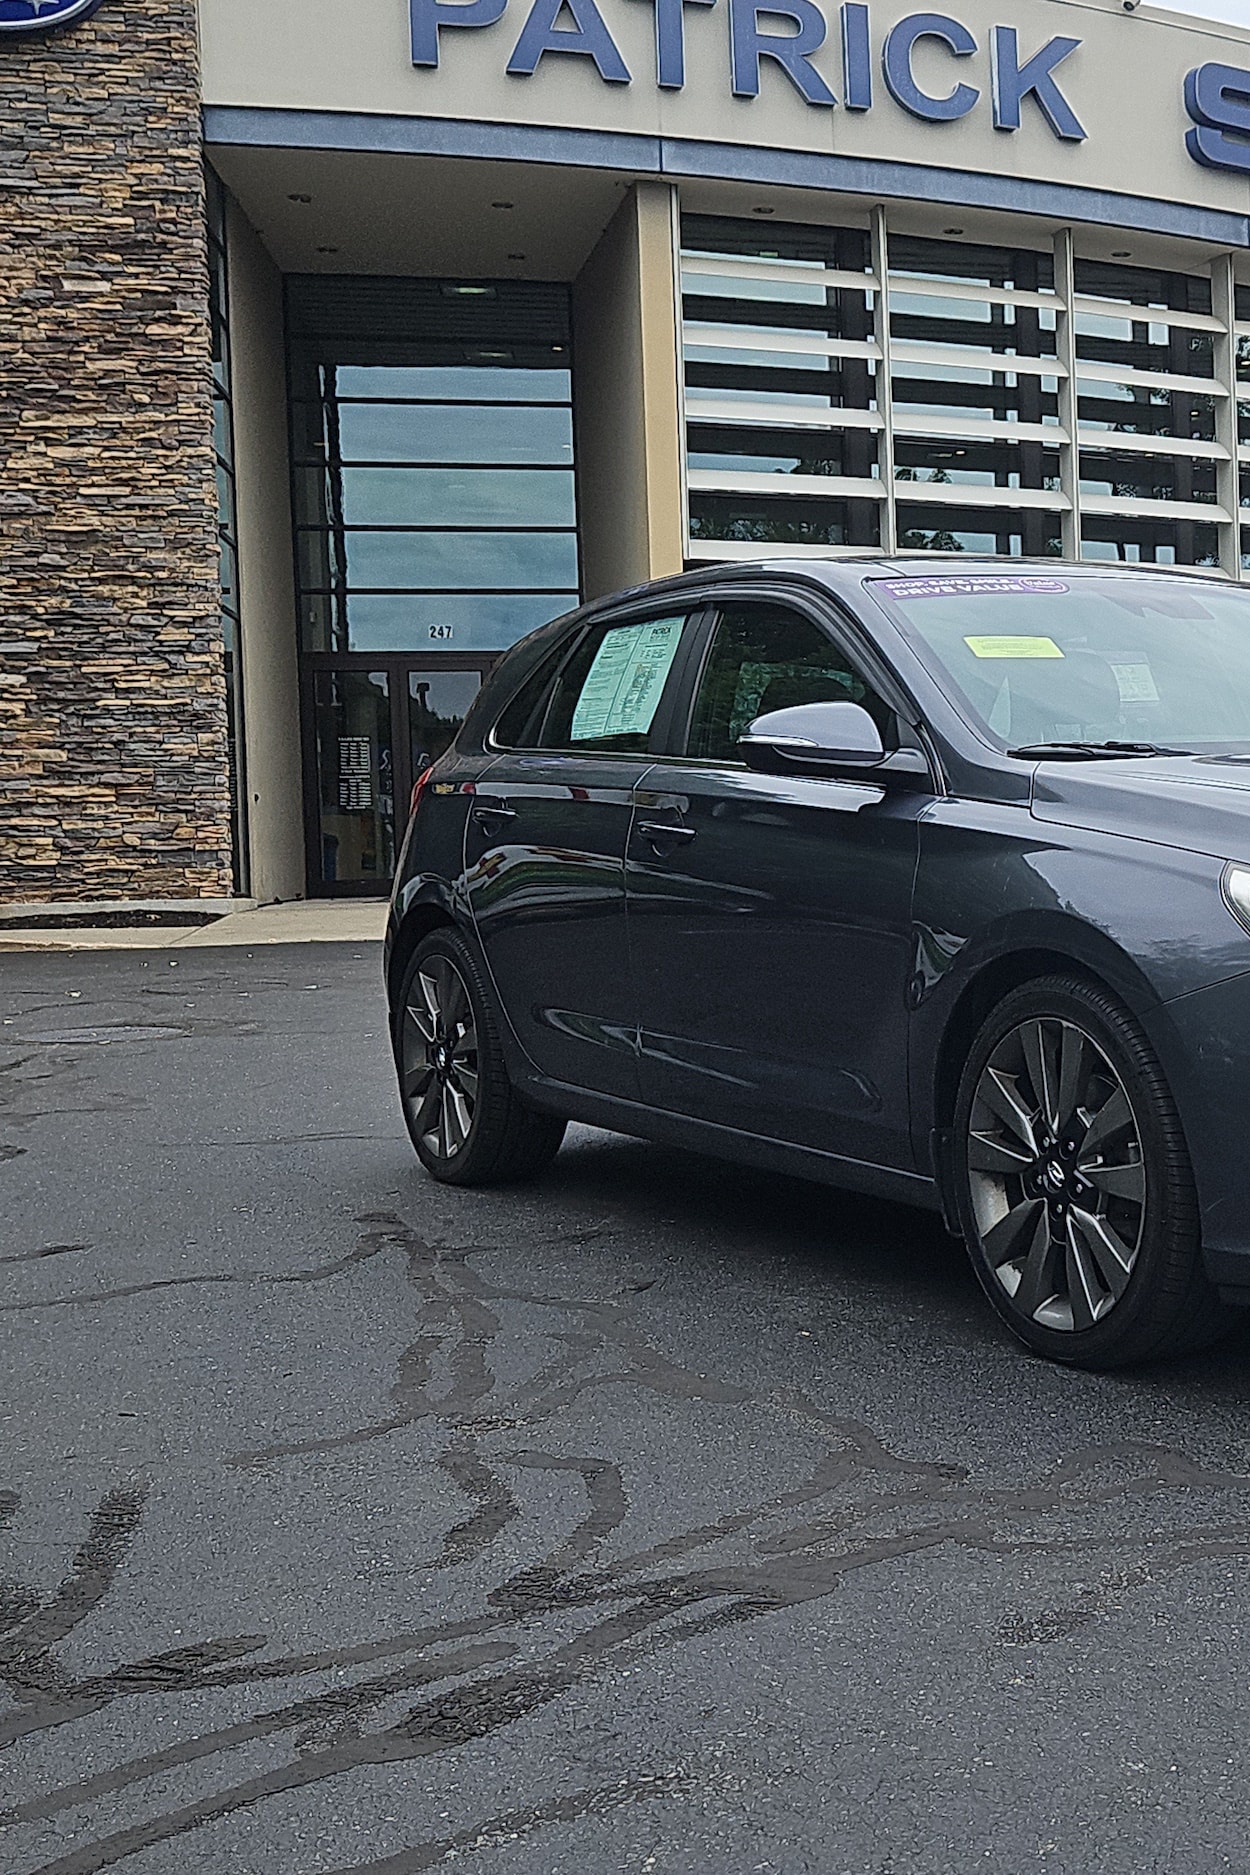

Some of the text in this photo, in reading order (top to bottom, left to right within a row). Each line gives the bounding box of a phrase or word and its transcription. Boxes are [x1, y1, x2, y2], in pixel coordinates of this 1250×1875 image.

[408, 0, 1087, 141] PATRICK
[892, 584, 1024, 596] DRIVE VALUE
[429, 625, 452, 639] 247
